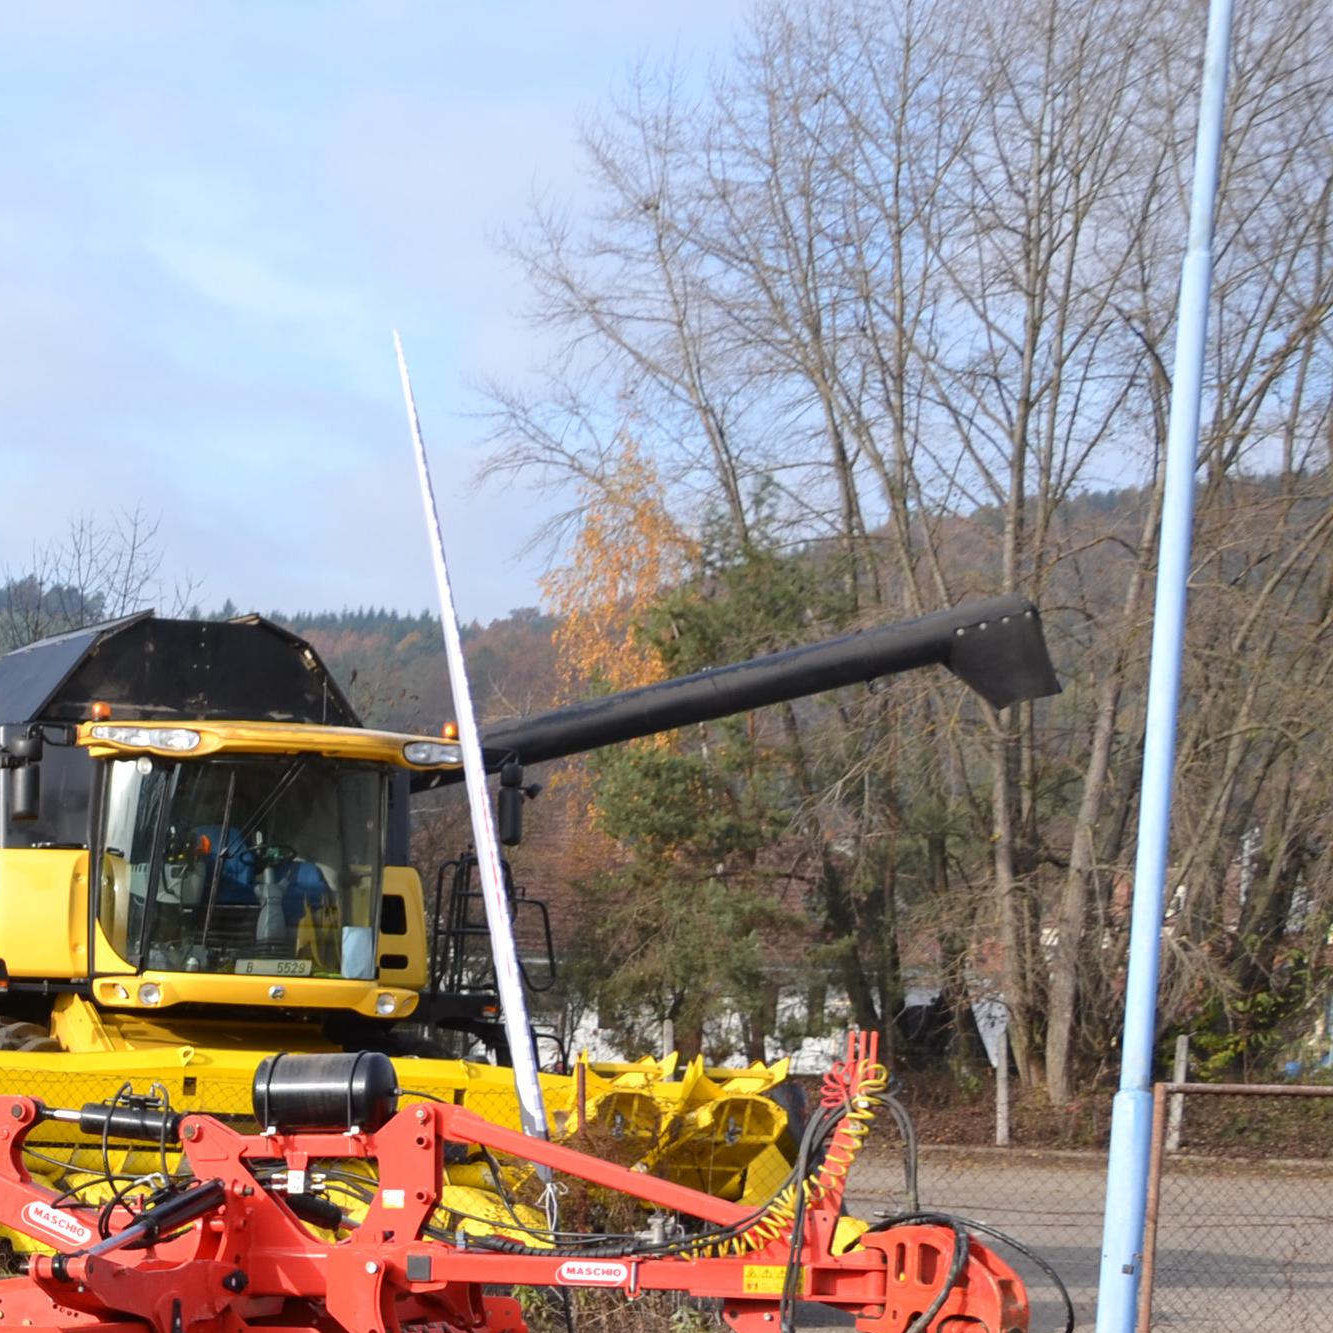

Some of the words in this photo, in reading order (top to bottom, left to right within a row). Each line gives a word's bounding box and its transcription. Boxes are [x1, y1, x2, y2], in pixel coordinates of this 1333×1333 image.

[246, 962, 254, 974] B
[277, 962, 306, 974] 5529
[33, 1207, 85, 1237] MASCHIO
[566, 1266, 622, 1277] MASCHIO
